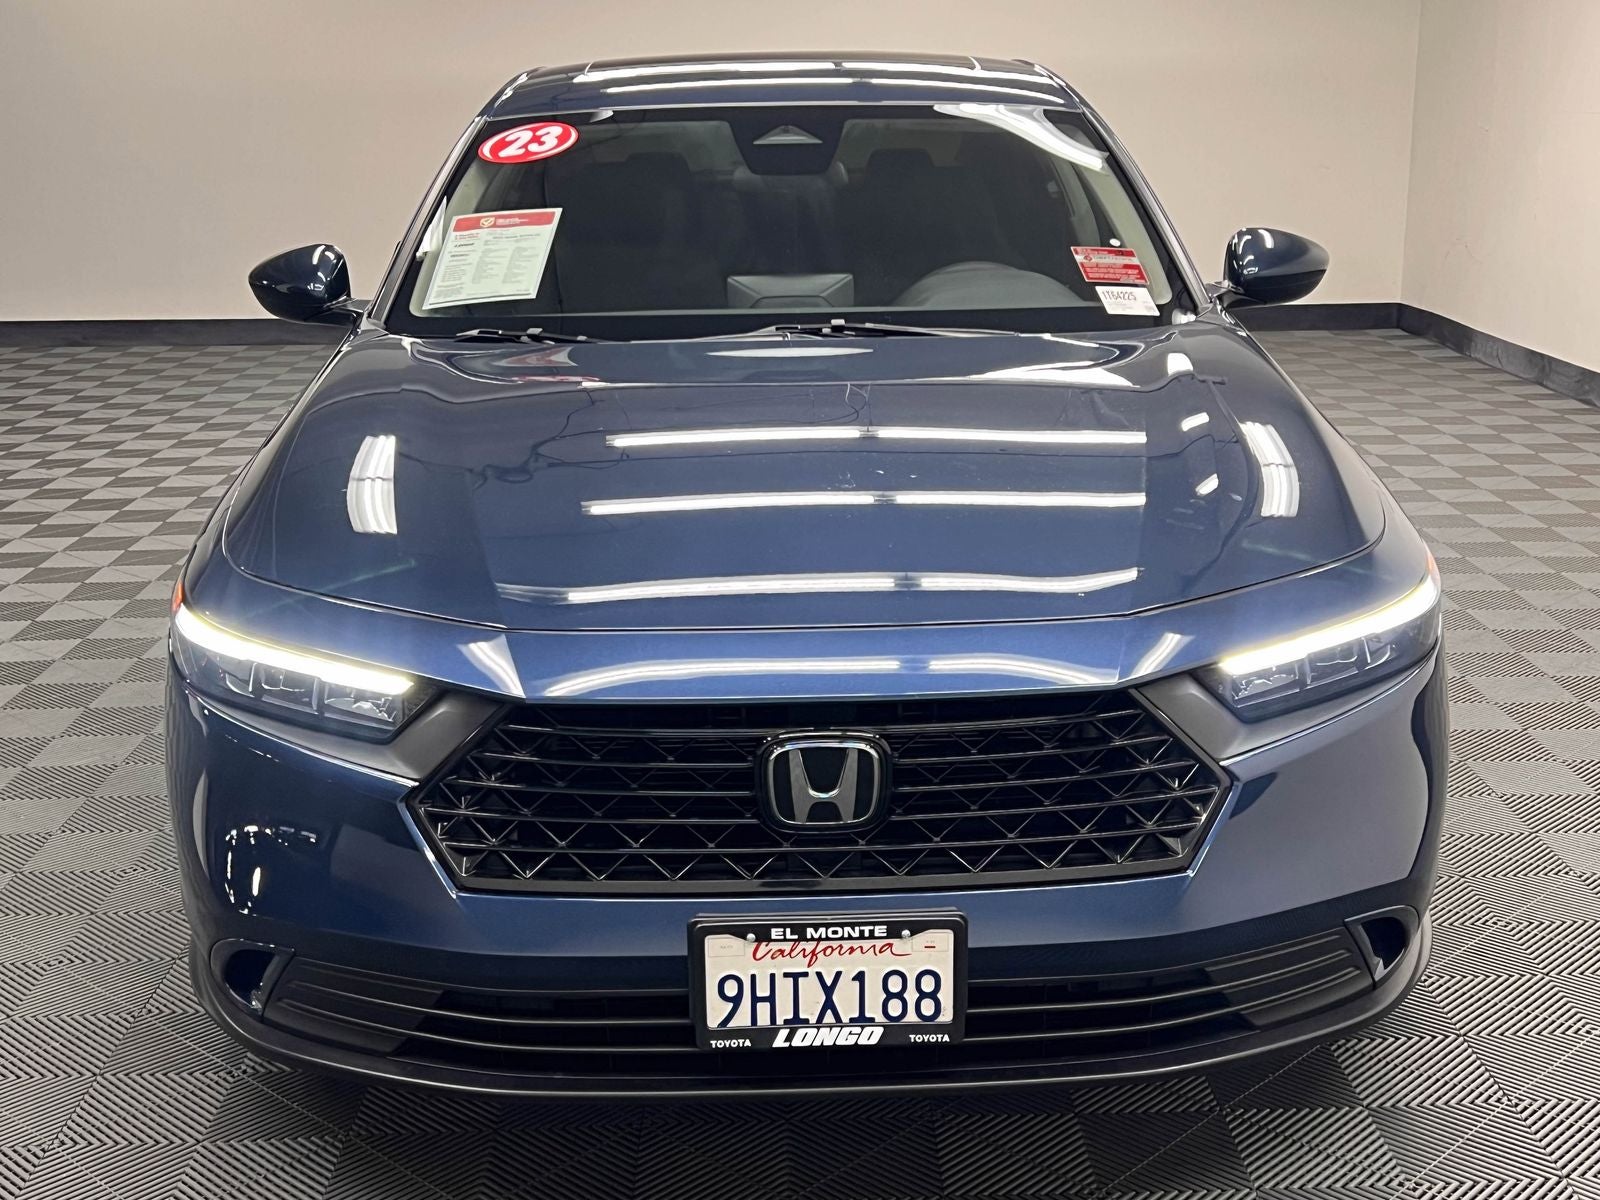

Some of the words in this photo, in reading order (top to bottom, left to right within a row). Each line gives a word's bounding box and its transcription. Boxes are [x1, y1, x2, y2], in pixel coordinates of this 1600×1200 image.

[497, 125, 563, 158] 23
[770, 927, 798, 939] EL
[806, 925, 887, 939] MONTE
[751, 941, 912, 968] California
[717, 969, 942, 1029] 9HIX188
[710, 1039, 752, 1049] TOYOTA
[772, 1026, 884, 1048] LONGO
[908, 1034, 950, 1043] TOYOTA
